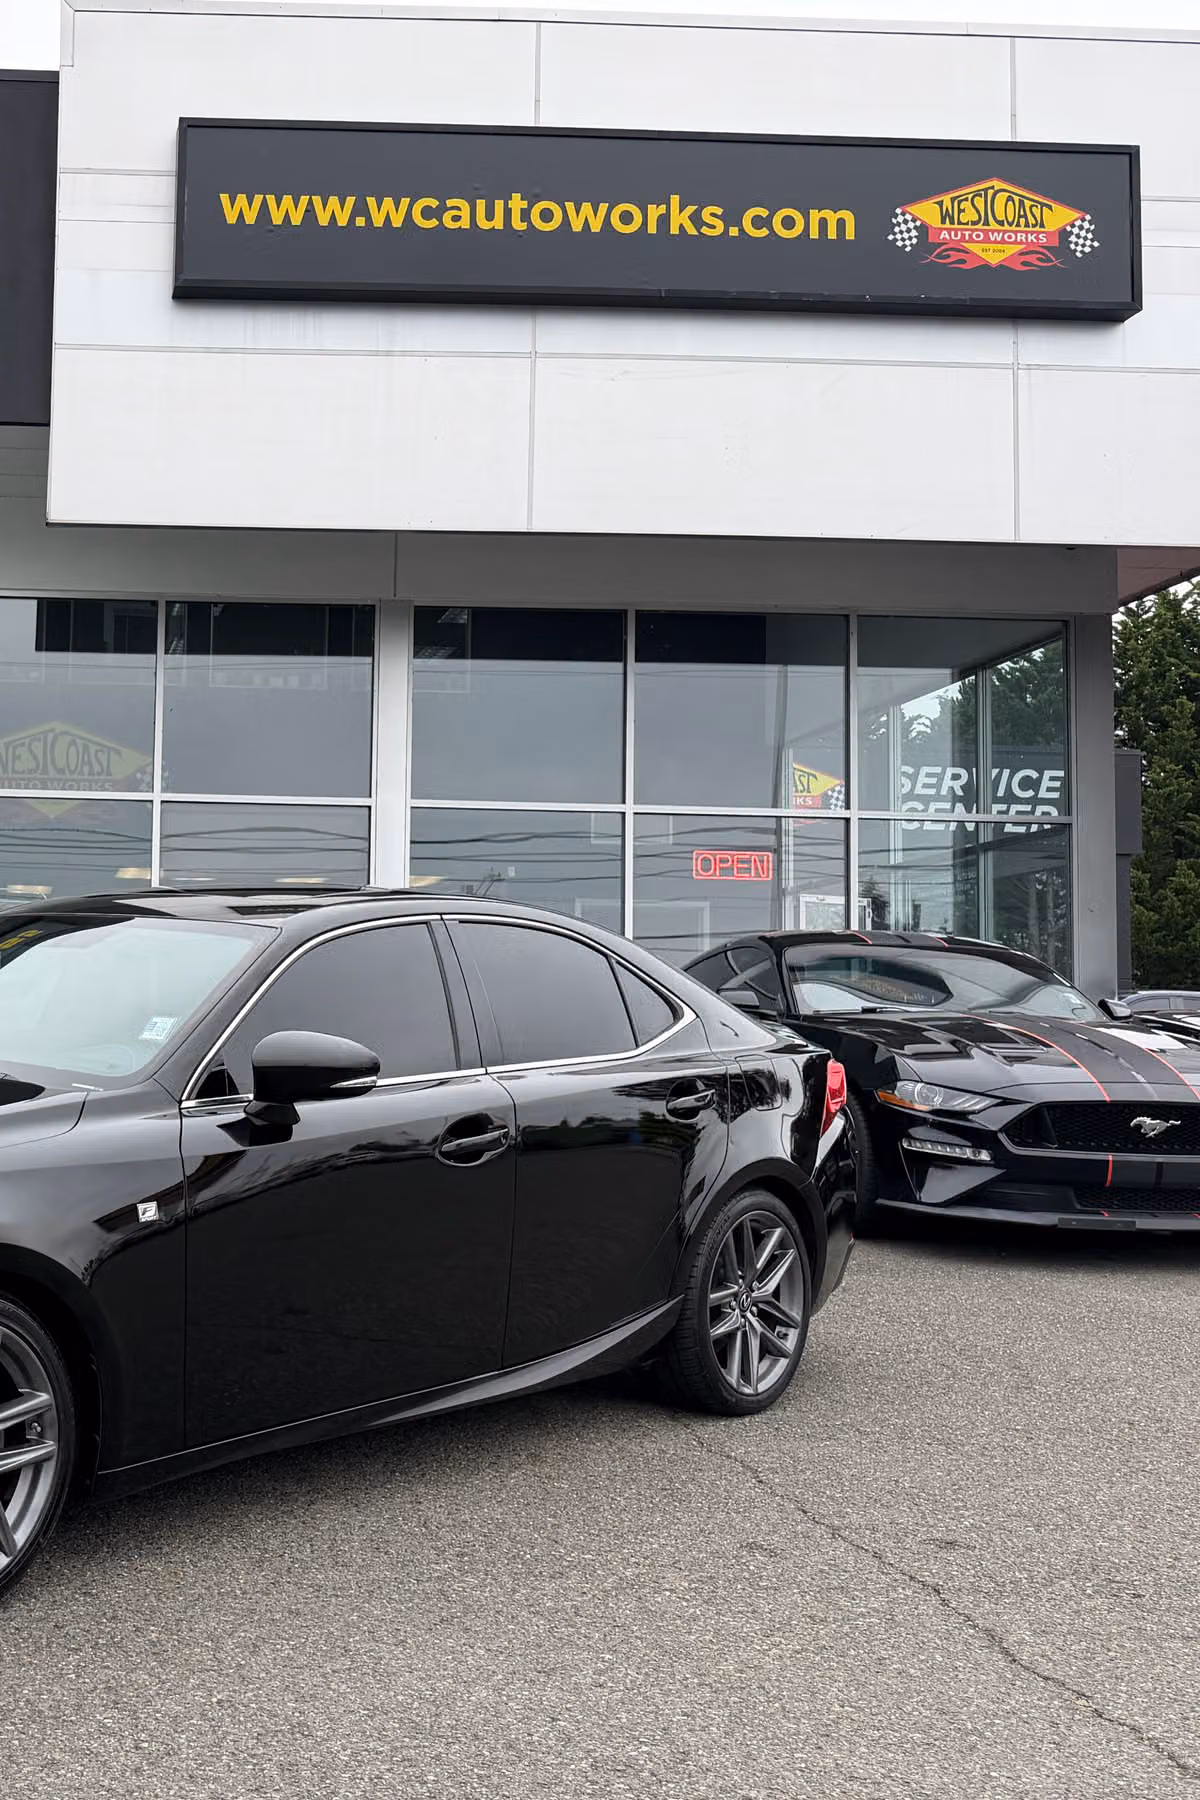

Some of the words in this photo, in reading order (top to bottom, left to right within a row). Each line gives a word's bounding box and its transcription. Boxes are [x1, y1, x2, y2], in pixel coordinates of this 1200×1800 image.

[219, 192, 856, 240] www.wcautoworks.com
[939, 230, 985, 241] AUTO
[989, 231, 1048, 243] WORKS
[697, 853, 768, 877] OPEN
